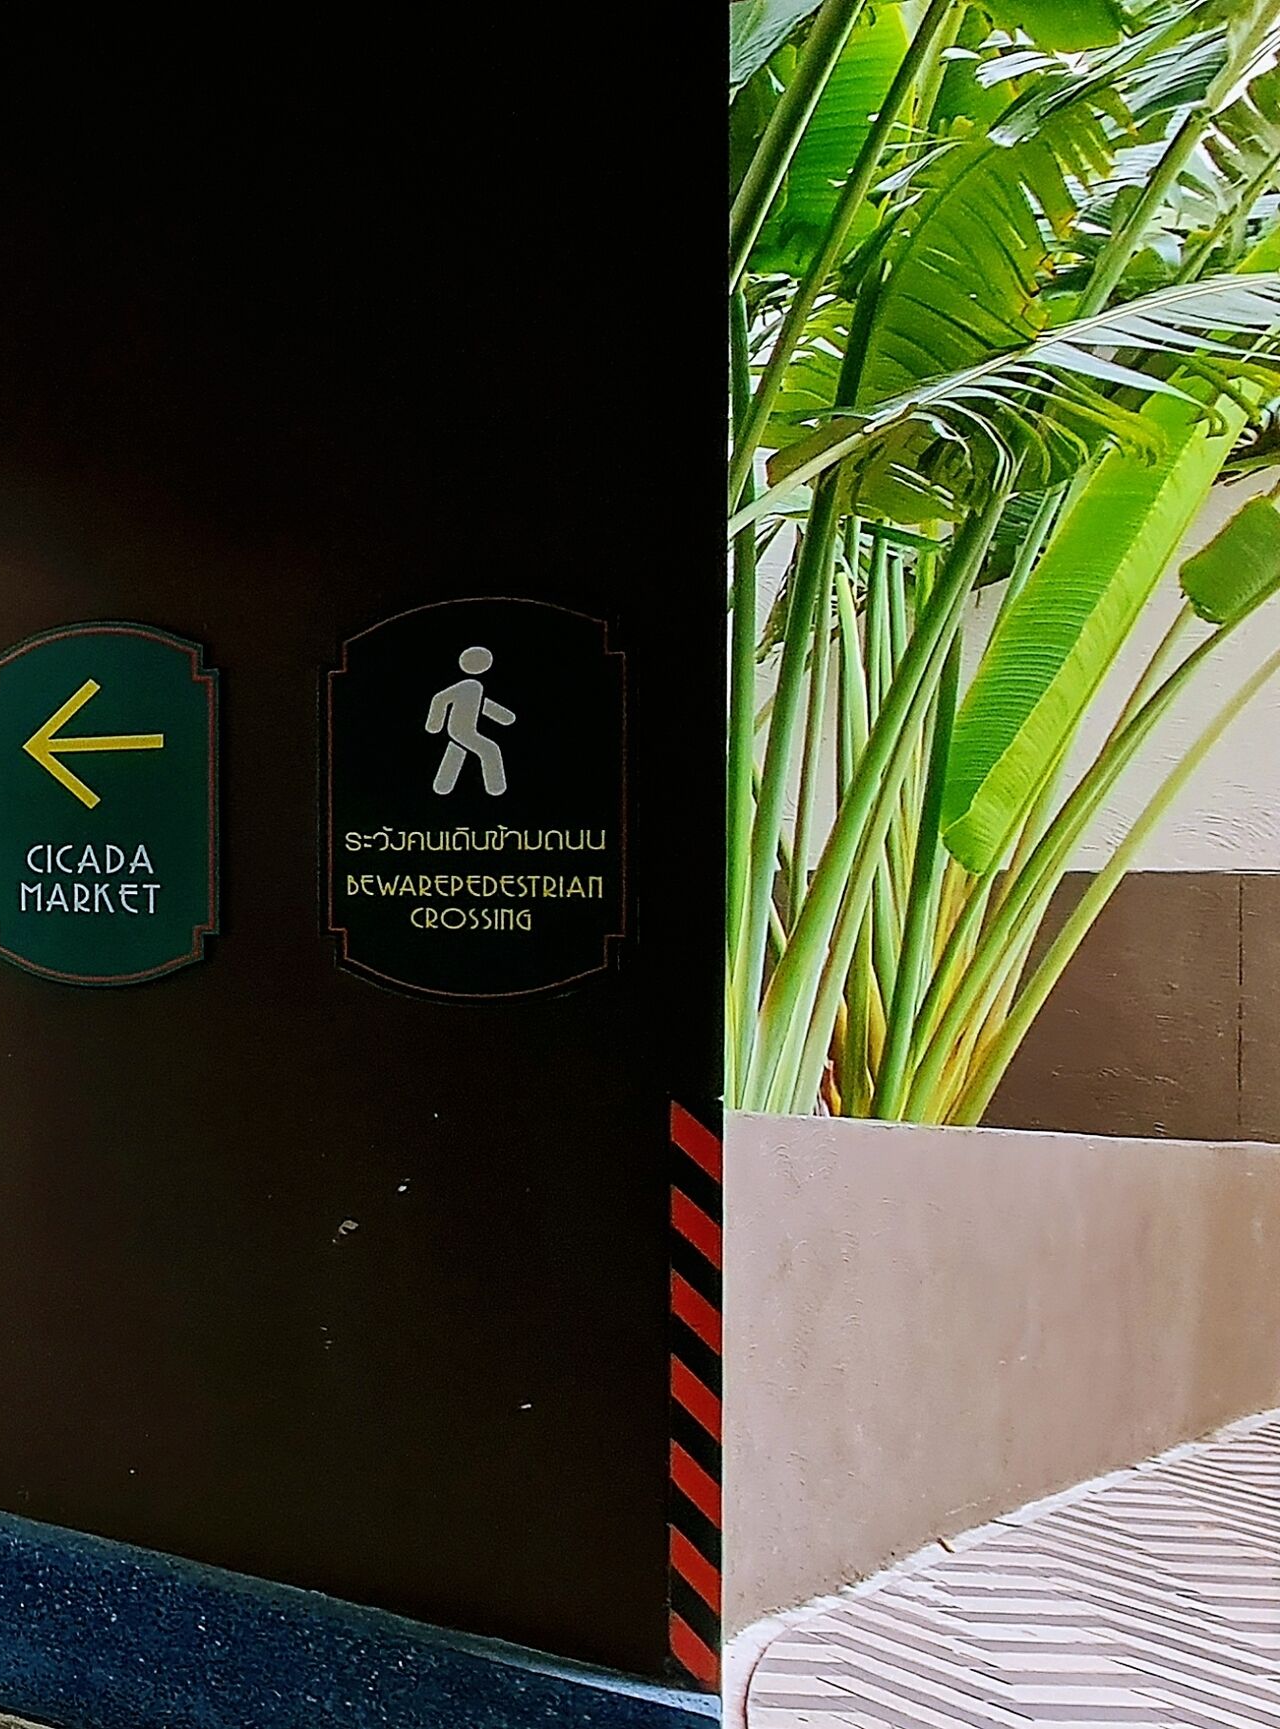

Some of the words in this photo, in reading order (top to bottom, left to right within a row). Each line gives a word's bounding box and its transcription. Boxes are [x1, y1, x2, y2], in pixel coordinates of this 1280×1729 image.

[345, 825, 606, 851] ระวังคนเดินข้ามถนน
[27, 844, 154, 874] CICADA
[20, 882, 161, 914] MARKET
[411, 907, 532, 931] CROSSING
